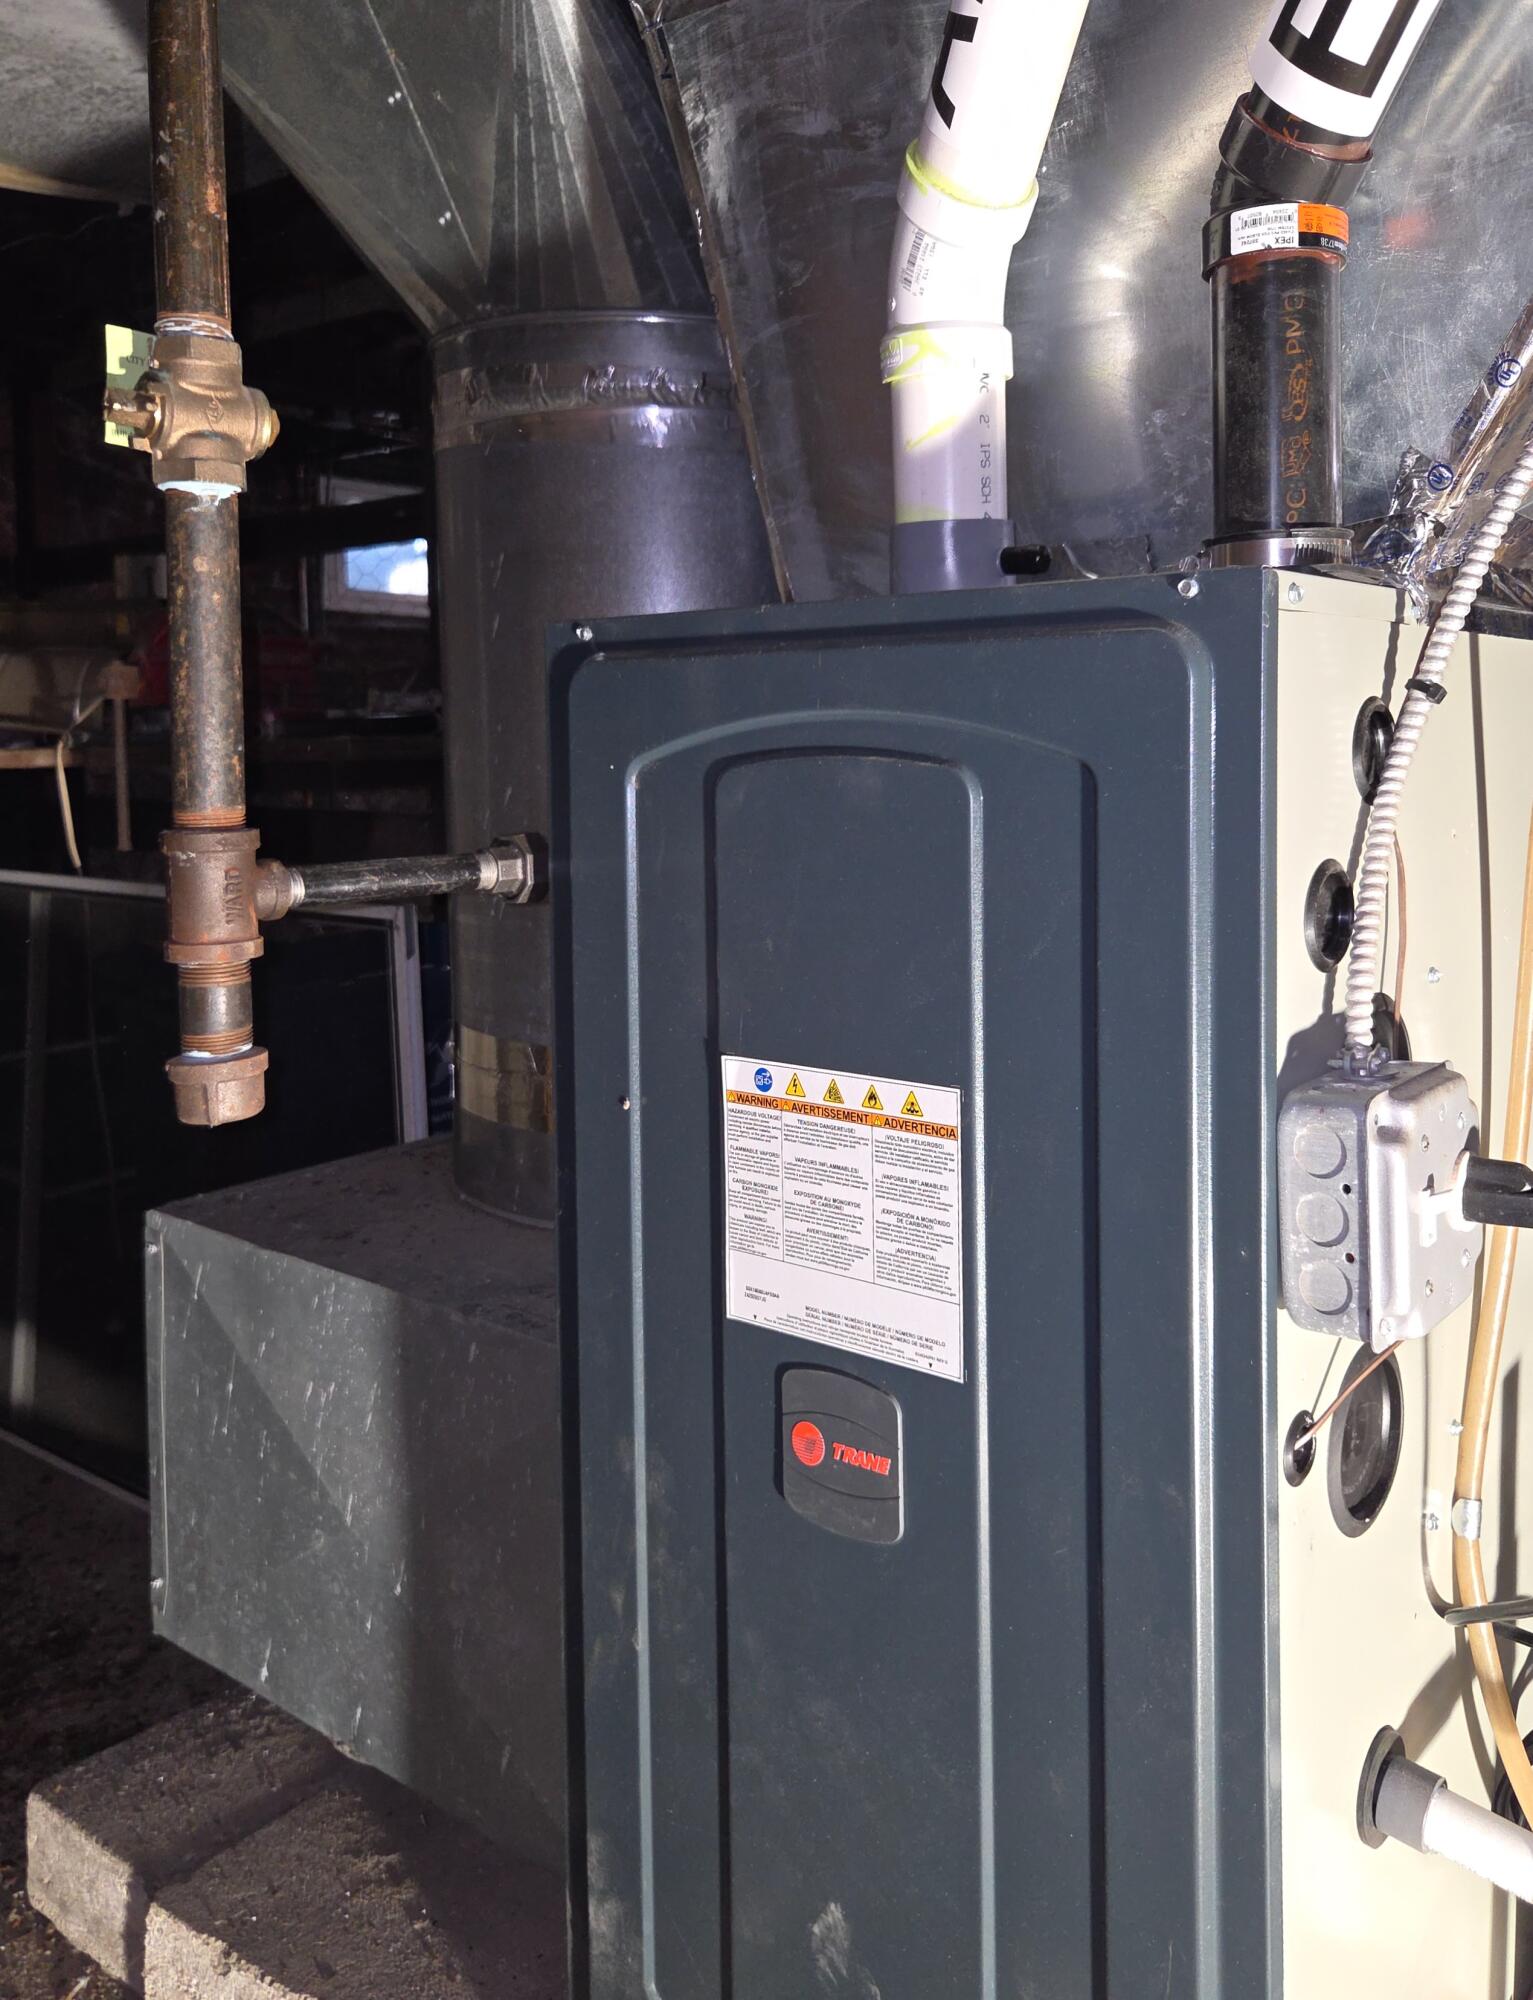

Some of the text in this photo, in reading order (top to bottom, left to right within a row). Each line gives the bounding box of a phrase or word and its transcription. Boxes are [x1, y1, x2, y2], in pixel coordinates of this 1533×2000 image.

[1274, 236, 1294, 244] IPEX
[979, 443, 992, 469] IPS
[981, 476, 993, 504] SCH
[223, 867, 242, 926] WARD
[737, 1093, 778, 1109] WARNING
[792, 1102, 869, 1124] AVERTISSEMENT
[798, 1119, 855, 1134] TENSION DANGEREUSE!
[884, 1117, 956, 1138] ADVERTENCIA
[885, 1134, 944, 1150] ¡VOLTAJE PELIGROSO!
[881, 1173, 907, 1184] ¡VAPORES
[794, 1190, 823, 1201] EXPOSITION
[807, 1227, 848, 1242] AVERTISSEMENT!
[895, 1247, 936, 1262] ¡ADVERTENCIA!
[832, 1442, 891, 1475] TRANE
